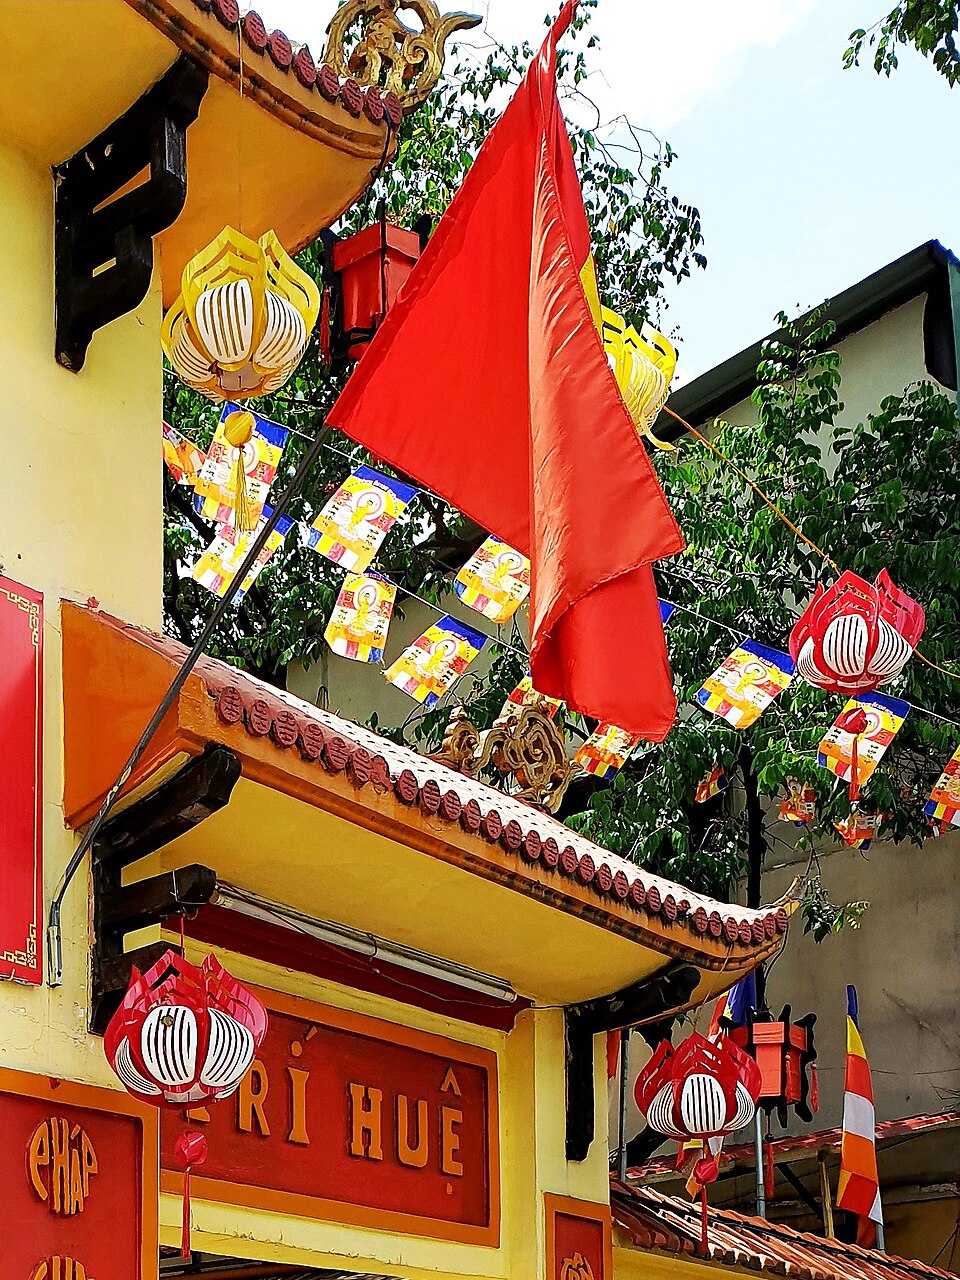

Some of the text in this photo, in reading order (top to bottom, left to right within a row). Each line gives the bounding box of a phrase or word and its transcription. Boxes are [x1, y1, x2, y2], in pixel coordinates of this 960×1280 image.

[29, 1116, 98, 1215] PHÁP
[186, 1025, 464, 1195] RÍ HUỆ
